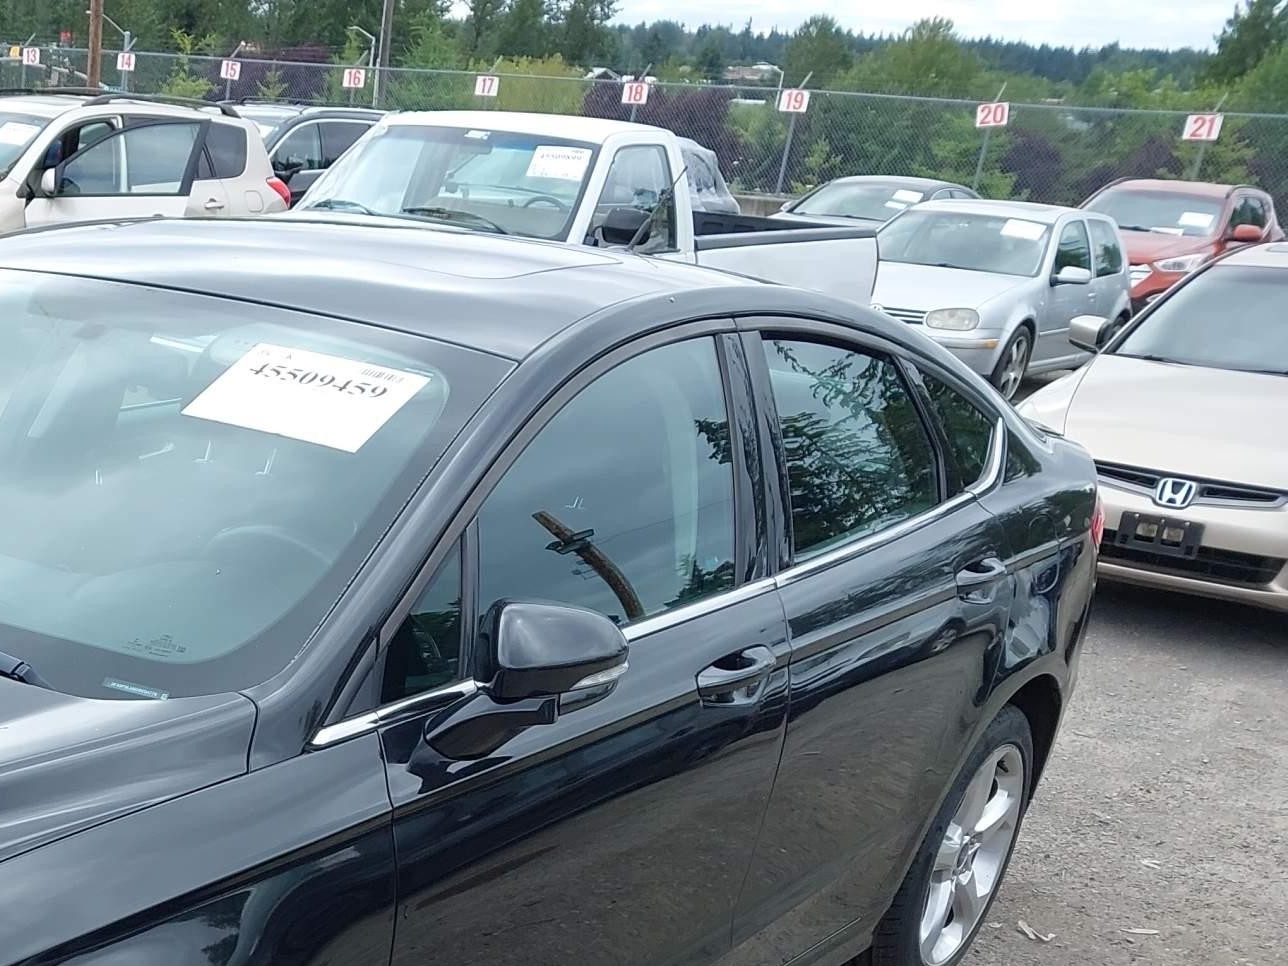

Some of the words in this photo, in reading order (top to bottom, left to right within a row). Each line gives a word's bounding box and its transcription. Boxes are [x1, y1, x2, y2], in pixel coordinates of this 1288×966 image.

[26, 49, 37, 64] 13
[121, 54, 132, 69] 14
[224, 61, 238, 78] 15
[347, 69, 361, 86] 16
[480, 77, 495, 94] 17
[627, 84, 644, 102] 18
[786, 91, 805, 110] 19
[980, 104, 1006, 126] 20
[1189, 115, 1218, 138] 21
[249, 361, 389, 399] 45509459
